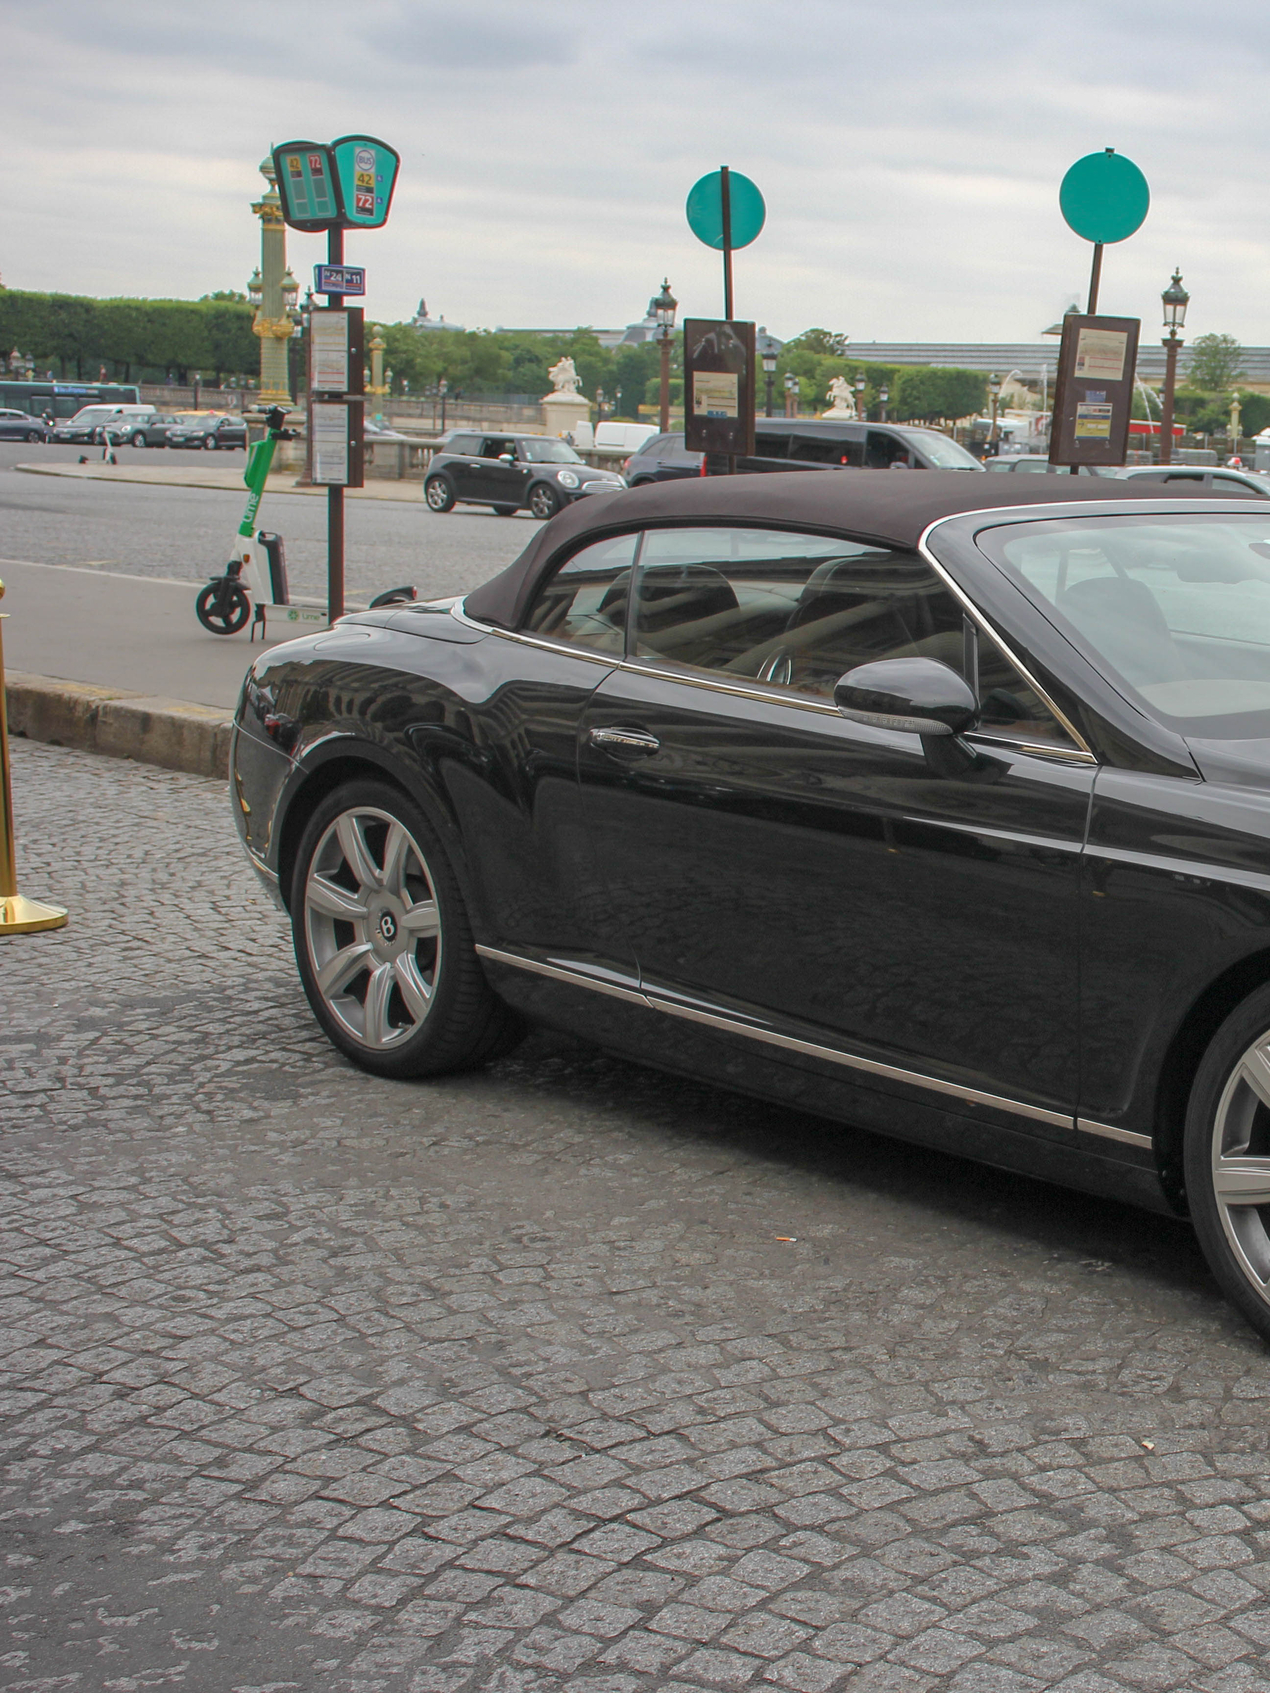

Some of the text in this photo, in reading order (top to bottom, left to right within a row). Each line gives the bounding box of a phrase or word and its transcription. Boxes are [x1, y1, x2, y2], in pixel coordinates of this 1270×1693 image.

[310, 156, 321, 168] 72
[358, 155, 373, 166] BUS
[357, 173, 373, 186] 42
[357, 195, 373, 209] 72
[330, 271, 343, 281] 24
[352, 275, 361, 284] 11
